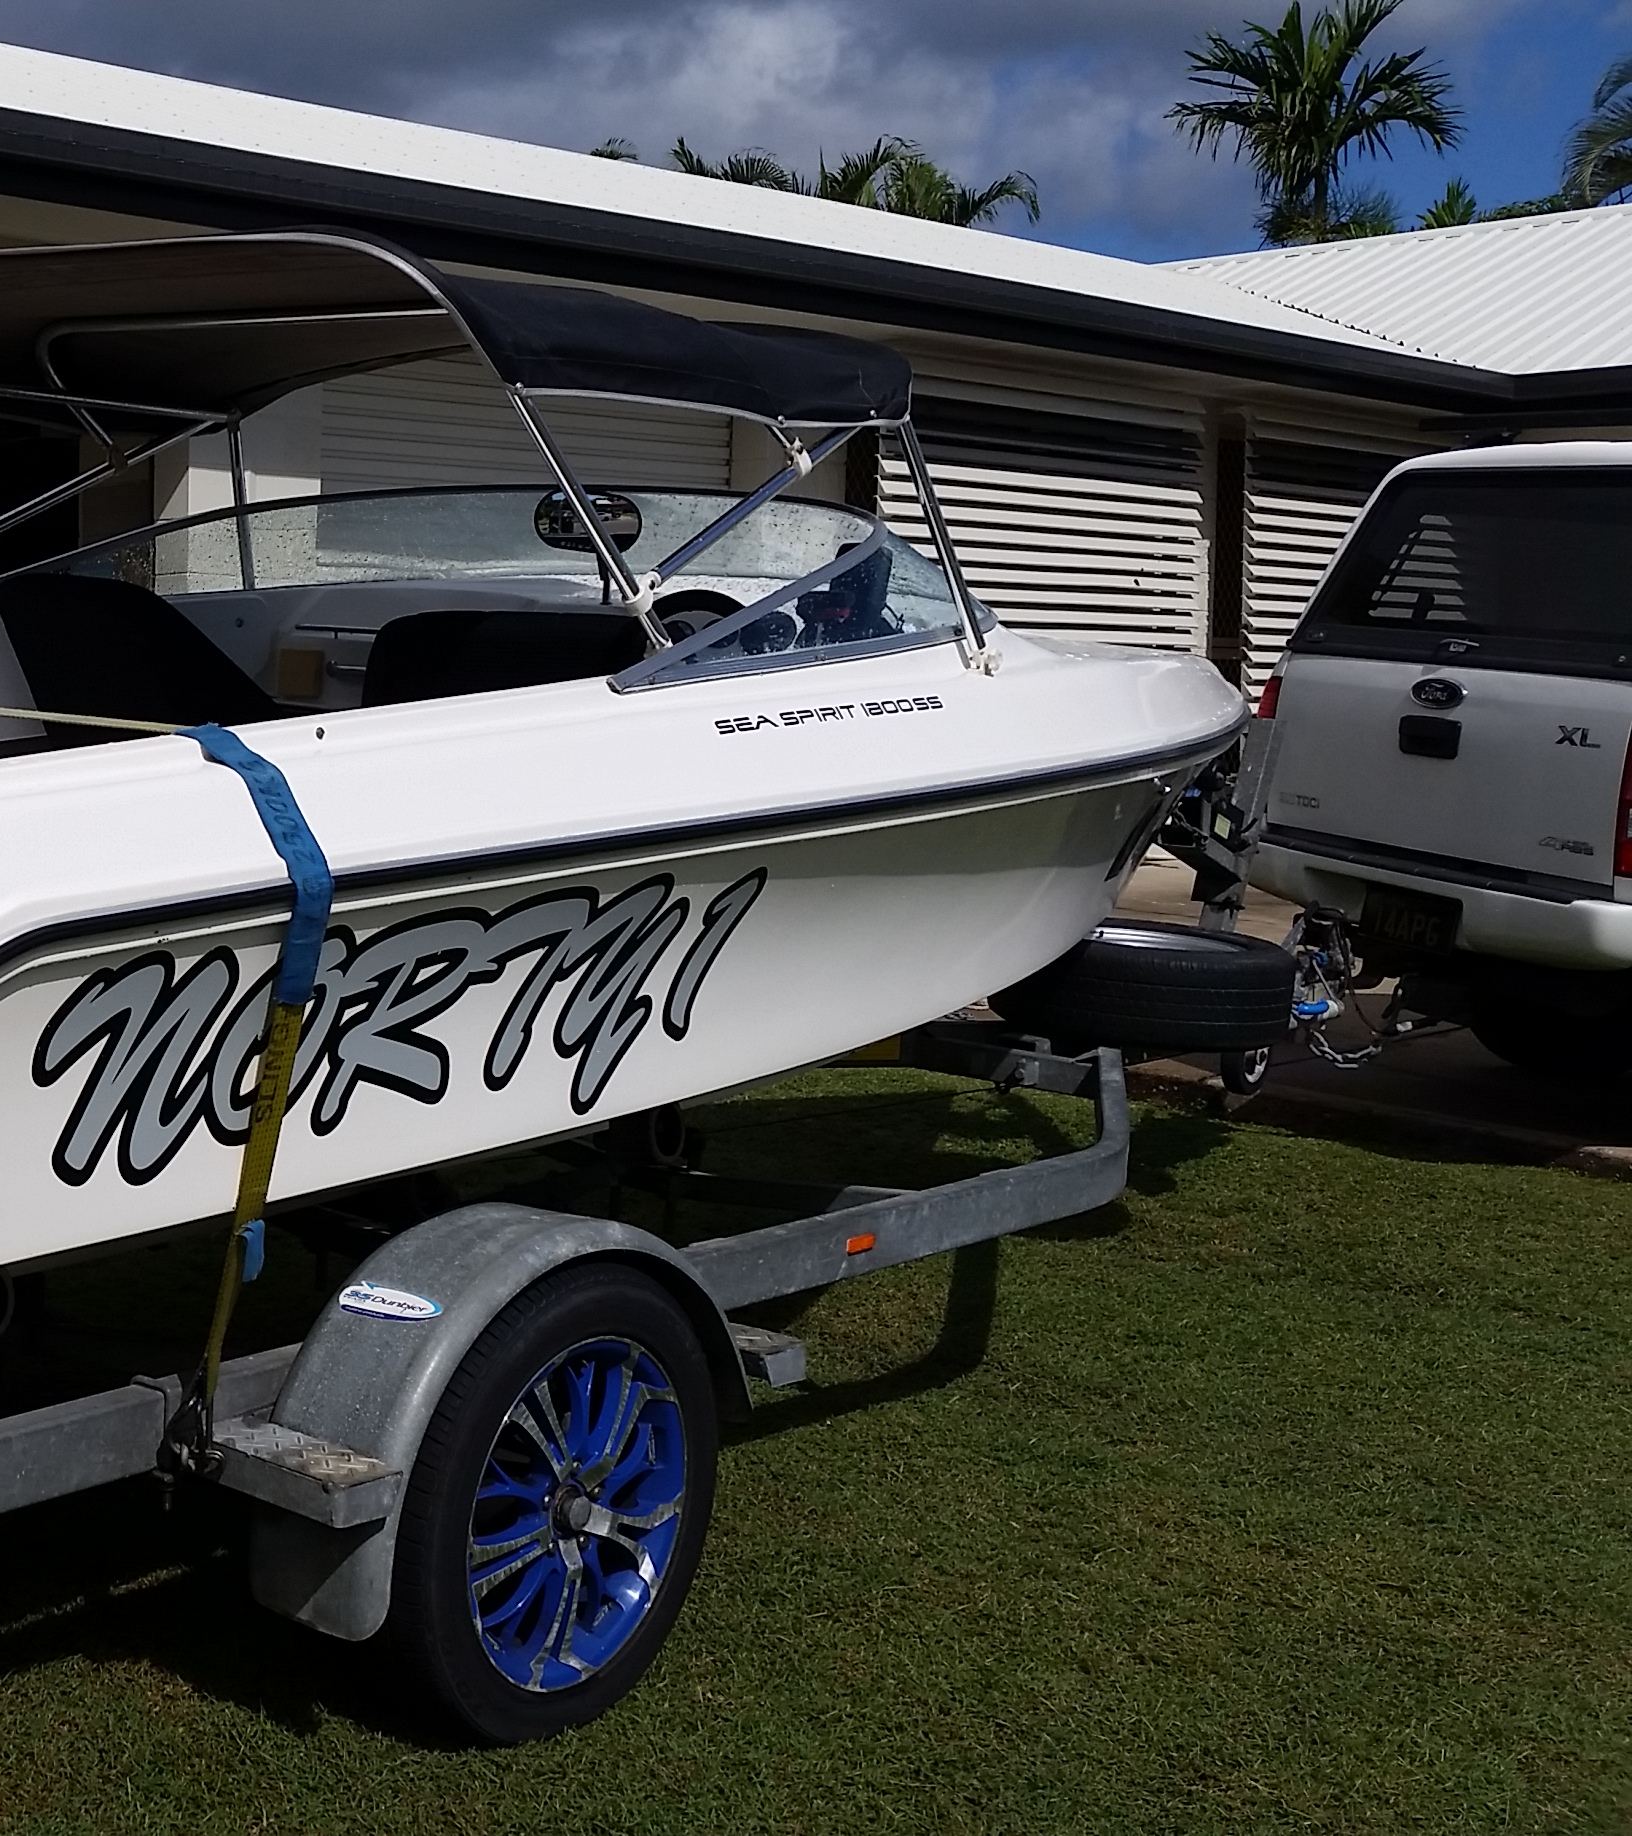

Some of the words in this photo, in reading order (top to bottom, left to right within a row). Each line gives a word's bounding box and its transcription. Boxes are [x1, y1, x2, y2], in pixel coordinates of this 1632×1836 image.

[714, 715, 779, 735] SEA
[779, 704, 855, 726] SPIRIT
[1555, 725, 1601, 749] XL
